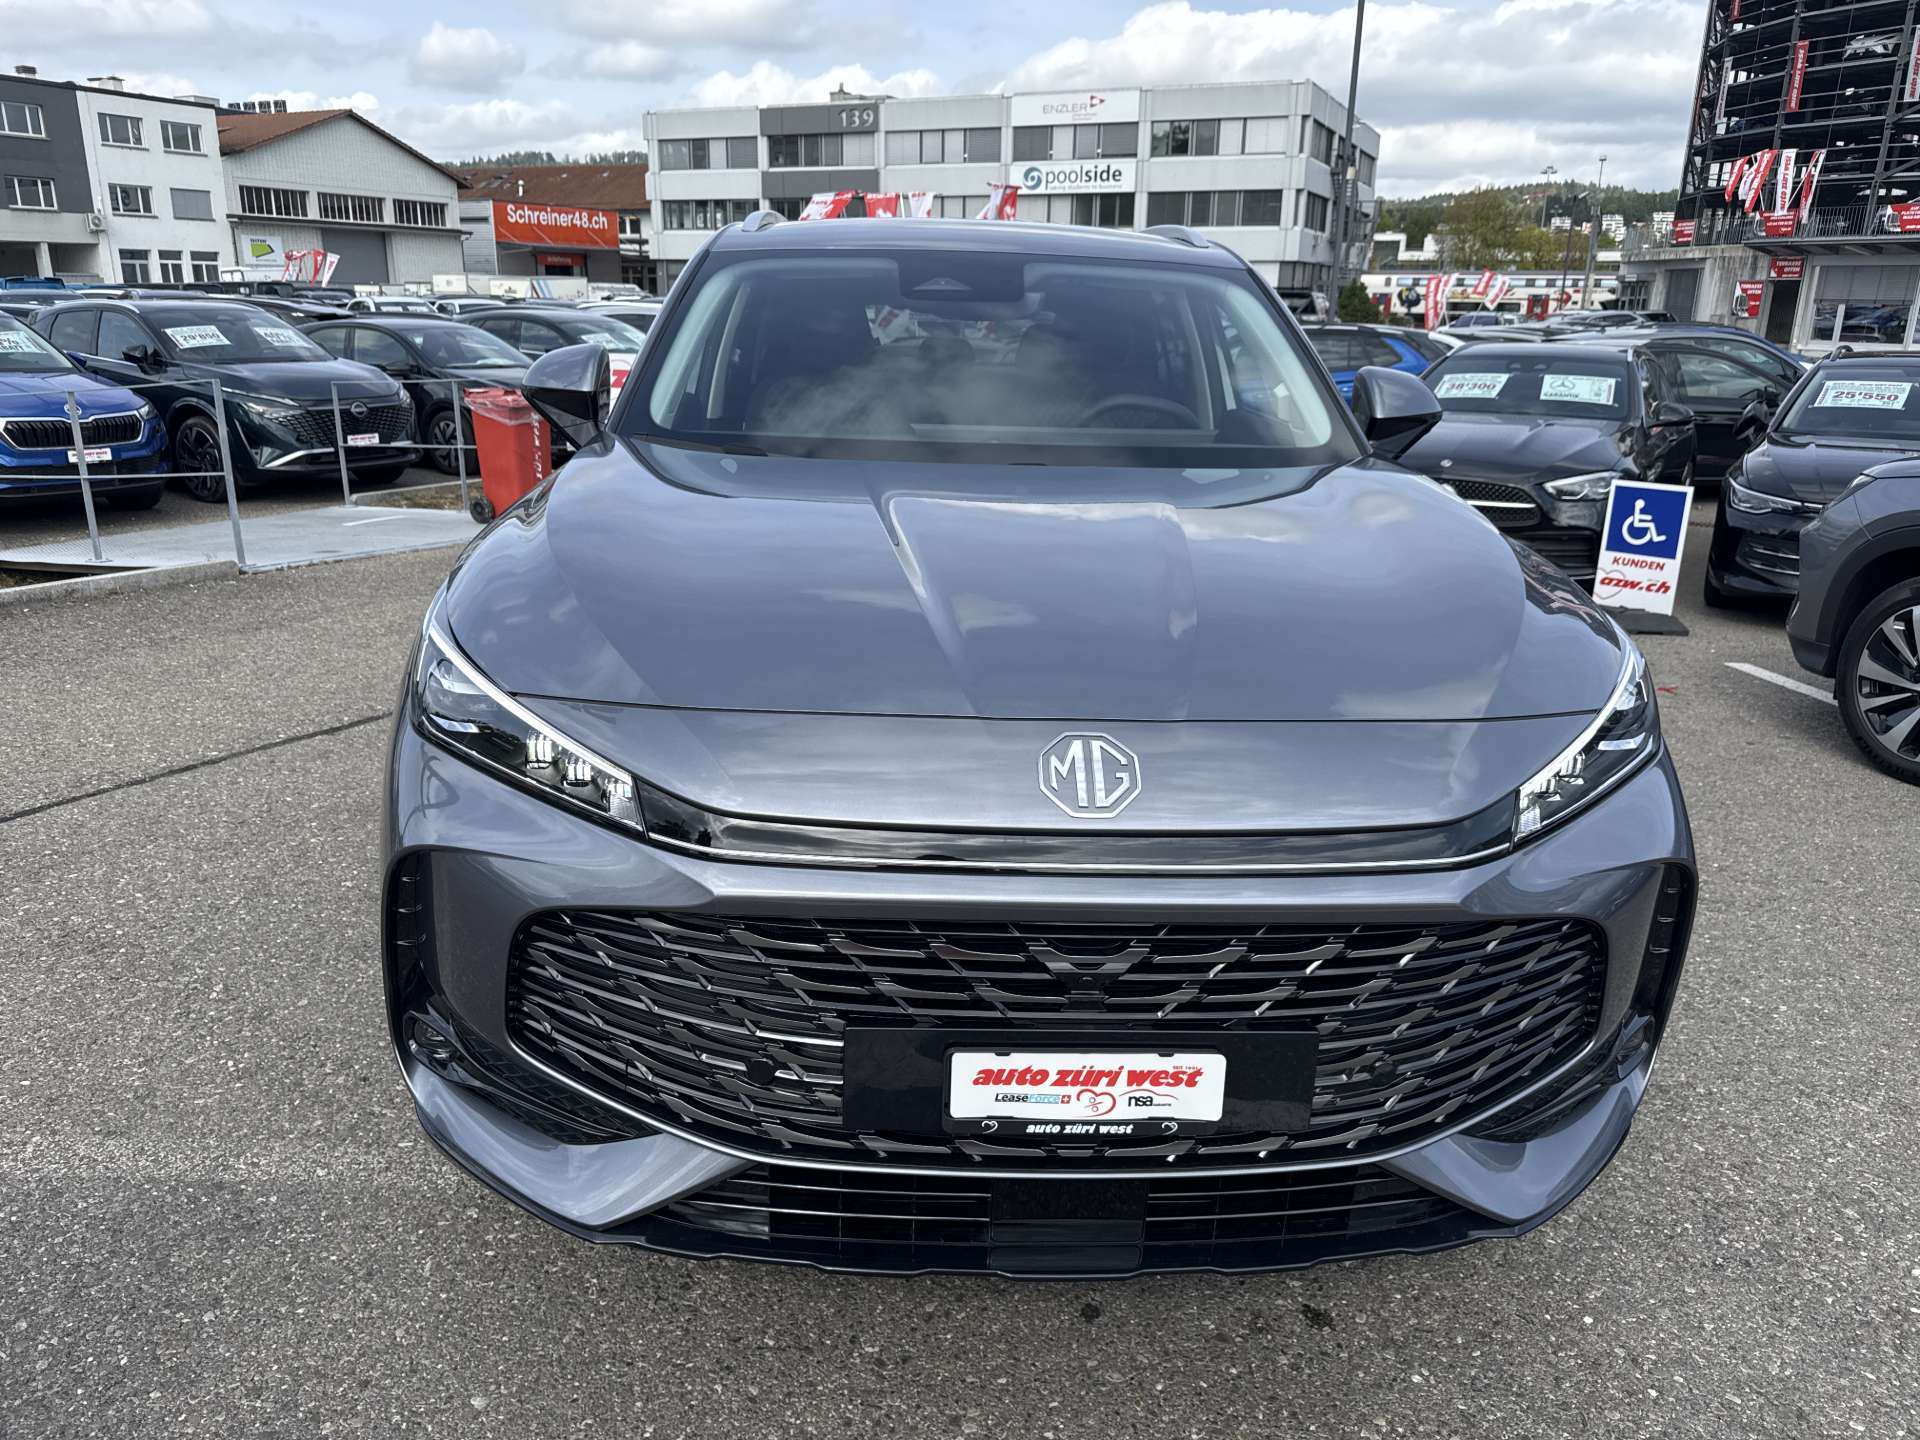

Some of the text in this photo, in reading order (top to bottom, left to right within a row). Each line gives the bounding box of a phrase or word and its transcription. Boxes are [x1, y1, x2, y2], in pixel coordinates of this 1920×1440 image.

[1042, 103, 1088, 114] ENZLER
[838, 109, 875, 128] 139
[1045, 163, 1123, 191] poolside
[507, 203, 608, 229] Schreiner48.ch
[1832, 391, 1899, 401] 25'550
[1612, 556, 1666, 571] KUNDEN
[1600, 576, 1671, 594] azw.ch
[1049, 739, 1130, 808] MG
[973, 1065, 1204, 1088] auto züri west
[1128, 1096, 1154, 1107] nsa
[1026, 1123, 1134, 1135] auto züri west
